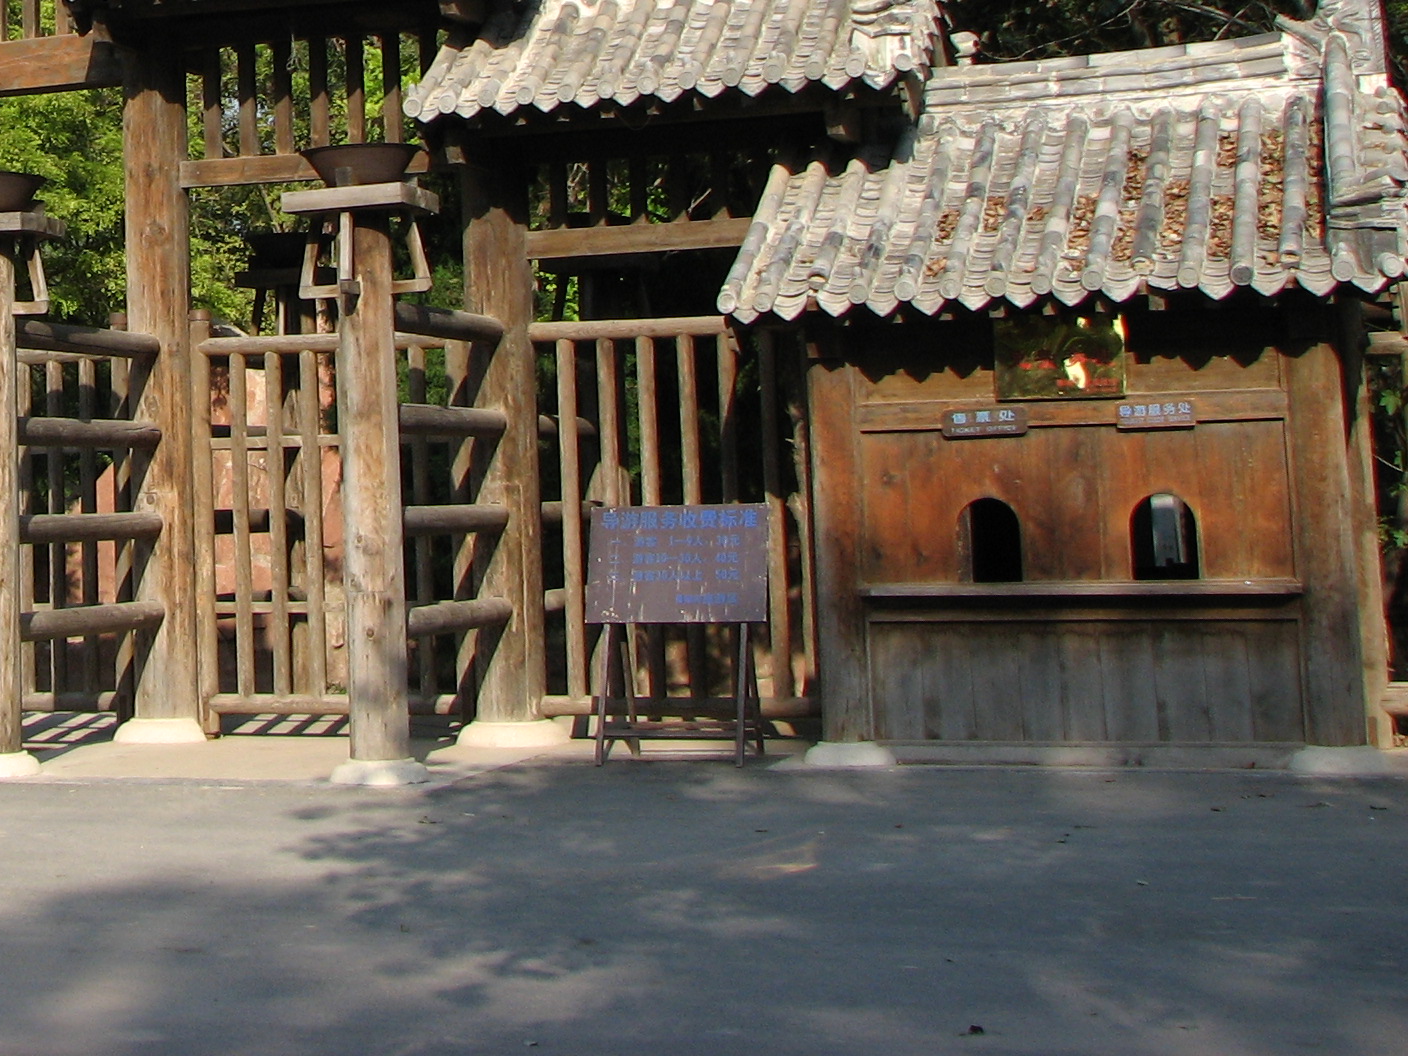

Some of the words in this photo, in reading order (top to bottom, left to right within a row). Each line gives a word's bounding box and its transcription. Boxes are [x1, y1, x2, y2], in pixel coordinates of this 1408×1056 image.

[952, 409, 1015, 424] 售票处
[1119, 402, 1191, 418] 导游服务处
[601, 509, 757, 530] 导游服务收费标准
